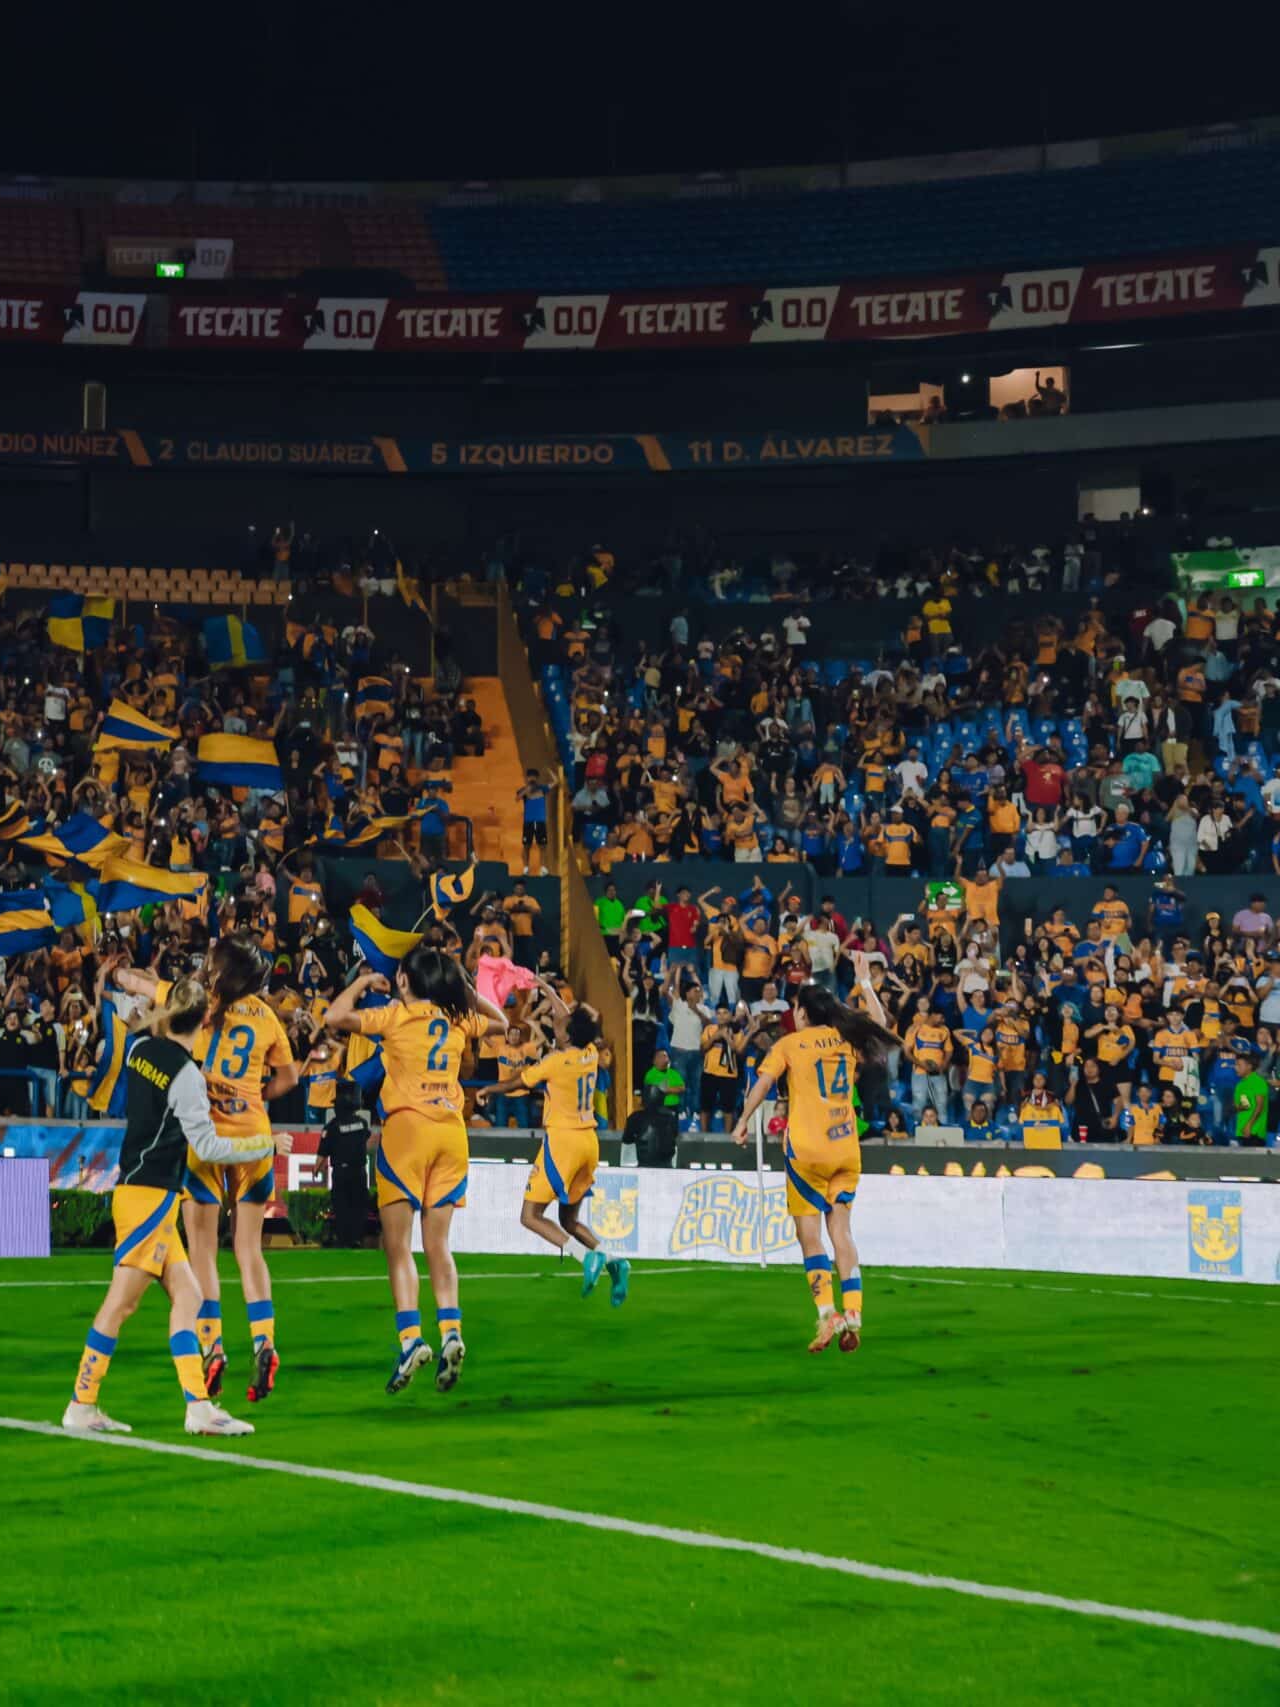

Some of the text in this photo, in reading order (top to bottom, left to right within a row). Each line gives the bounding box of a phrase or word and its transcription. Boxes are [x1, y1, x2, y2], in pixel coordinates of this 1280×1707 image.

[1092, 266, 1216, 307] TECATE
[178, 307, 283, 338] TECATE
[396, 307, 503, 339] TECATE
[620, 302, 727, 334] TECATE
[850, 289, 965, 326] TECATE
[43, 433, 118, 456] NUÑEZ
[159, 439, 374, 463] 2 CLAUDIO SUÁREZ
[432, 444, 613, 470] 5 IZQUIERDO
[689, 433, 895, 462] 11 D. ÁLVAREZ
[204, 1024, 255, 1080] 13
[426, 1018, 449, 1072] 2
[815, 1053, 850, 1098] 14
